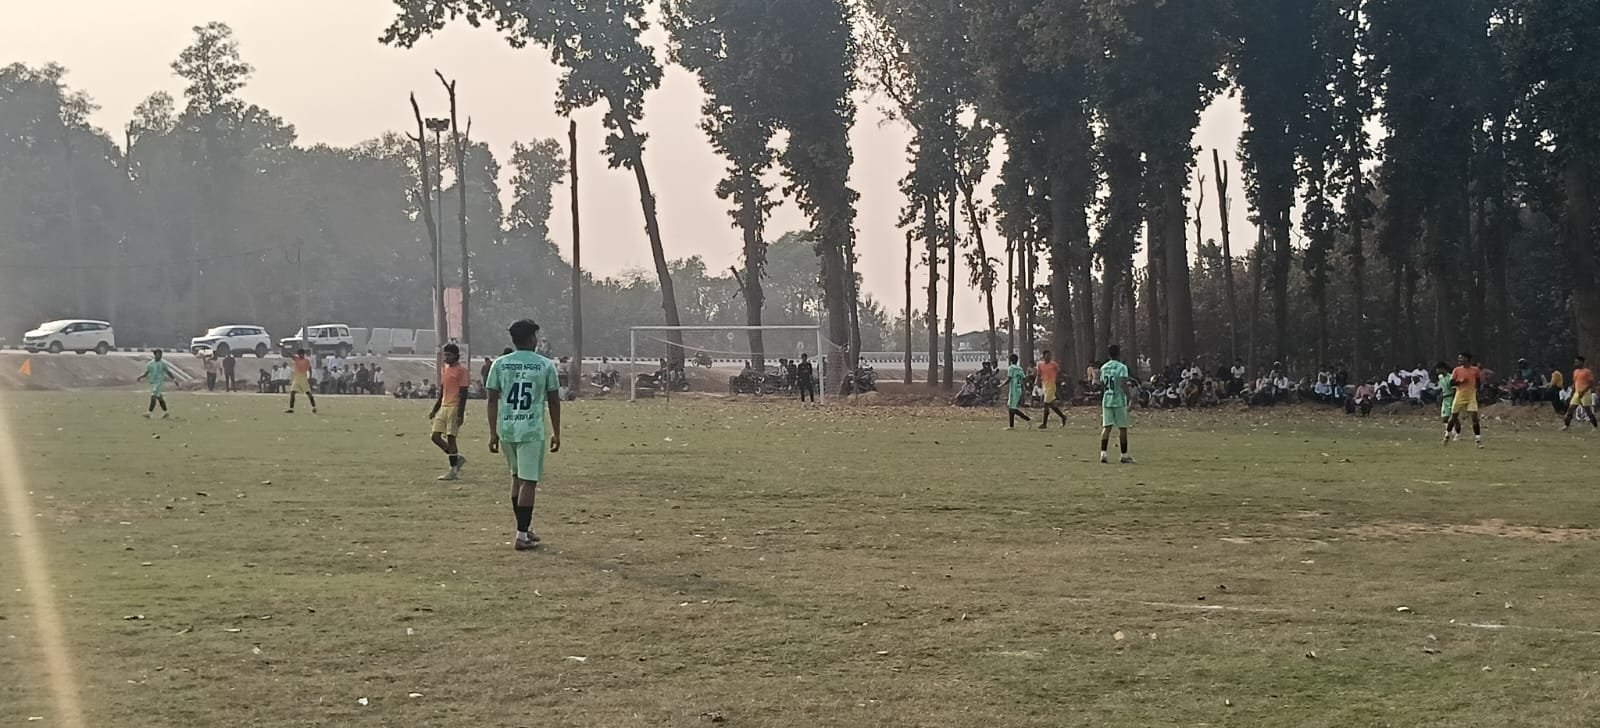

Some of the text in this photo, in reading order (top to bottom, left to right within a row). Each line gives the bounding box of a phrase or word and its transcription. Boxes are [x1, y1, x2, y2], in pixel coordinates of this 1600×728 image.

[501, 363, 541, 371] SARDAR NAGAR
[507, 382, 533, 410] 45
